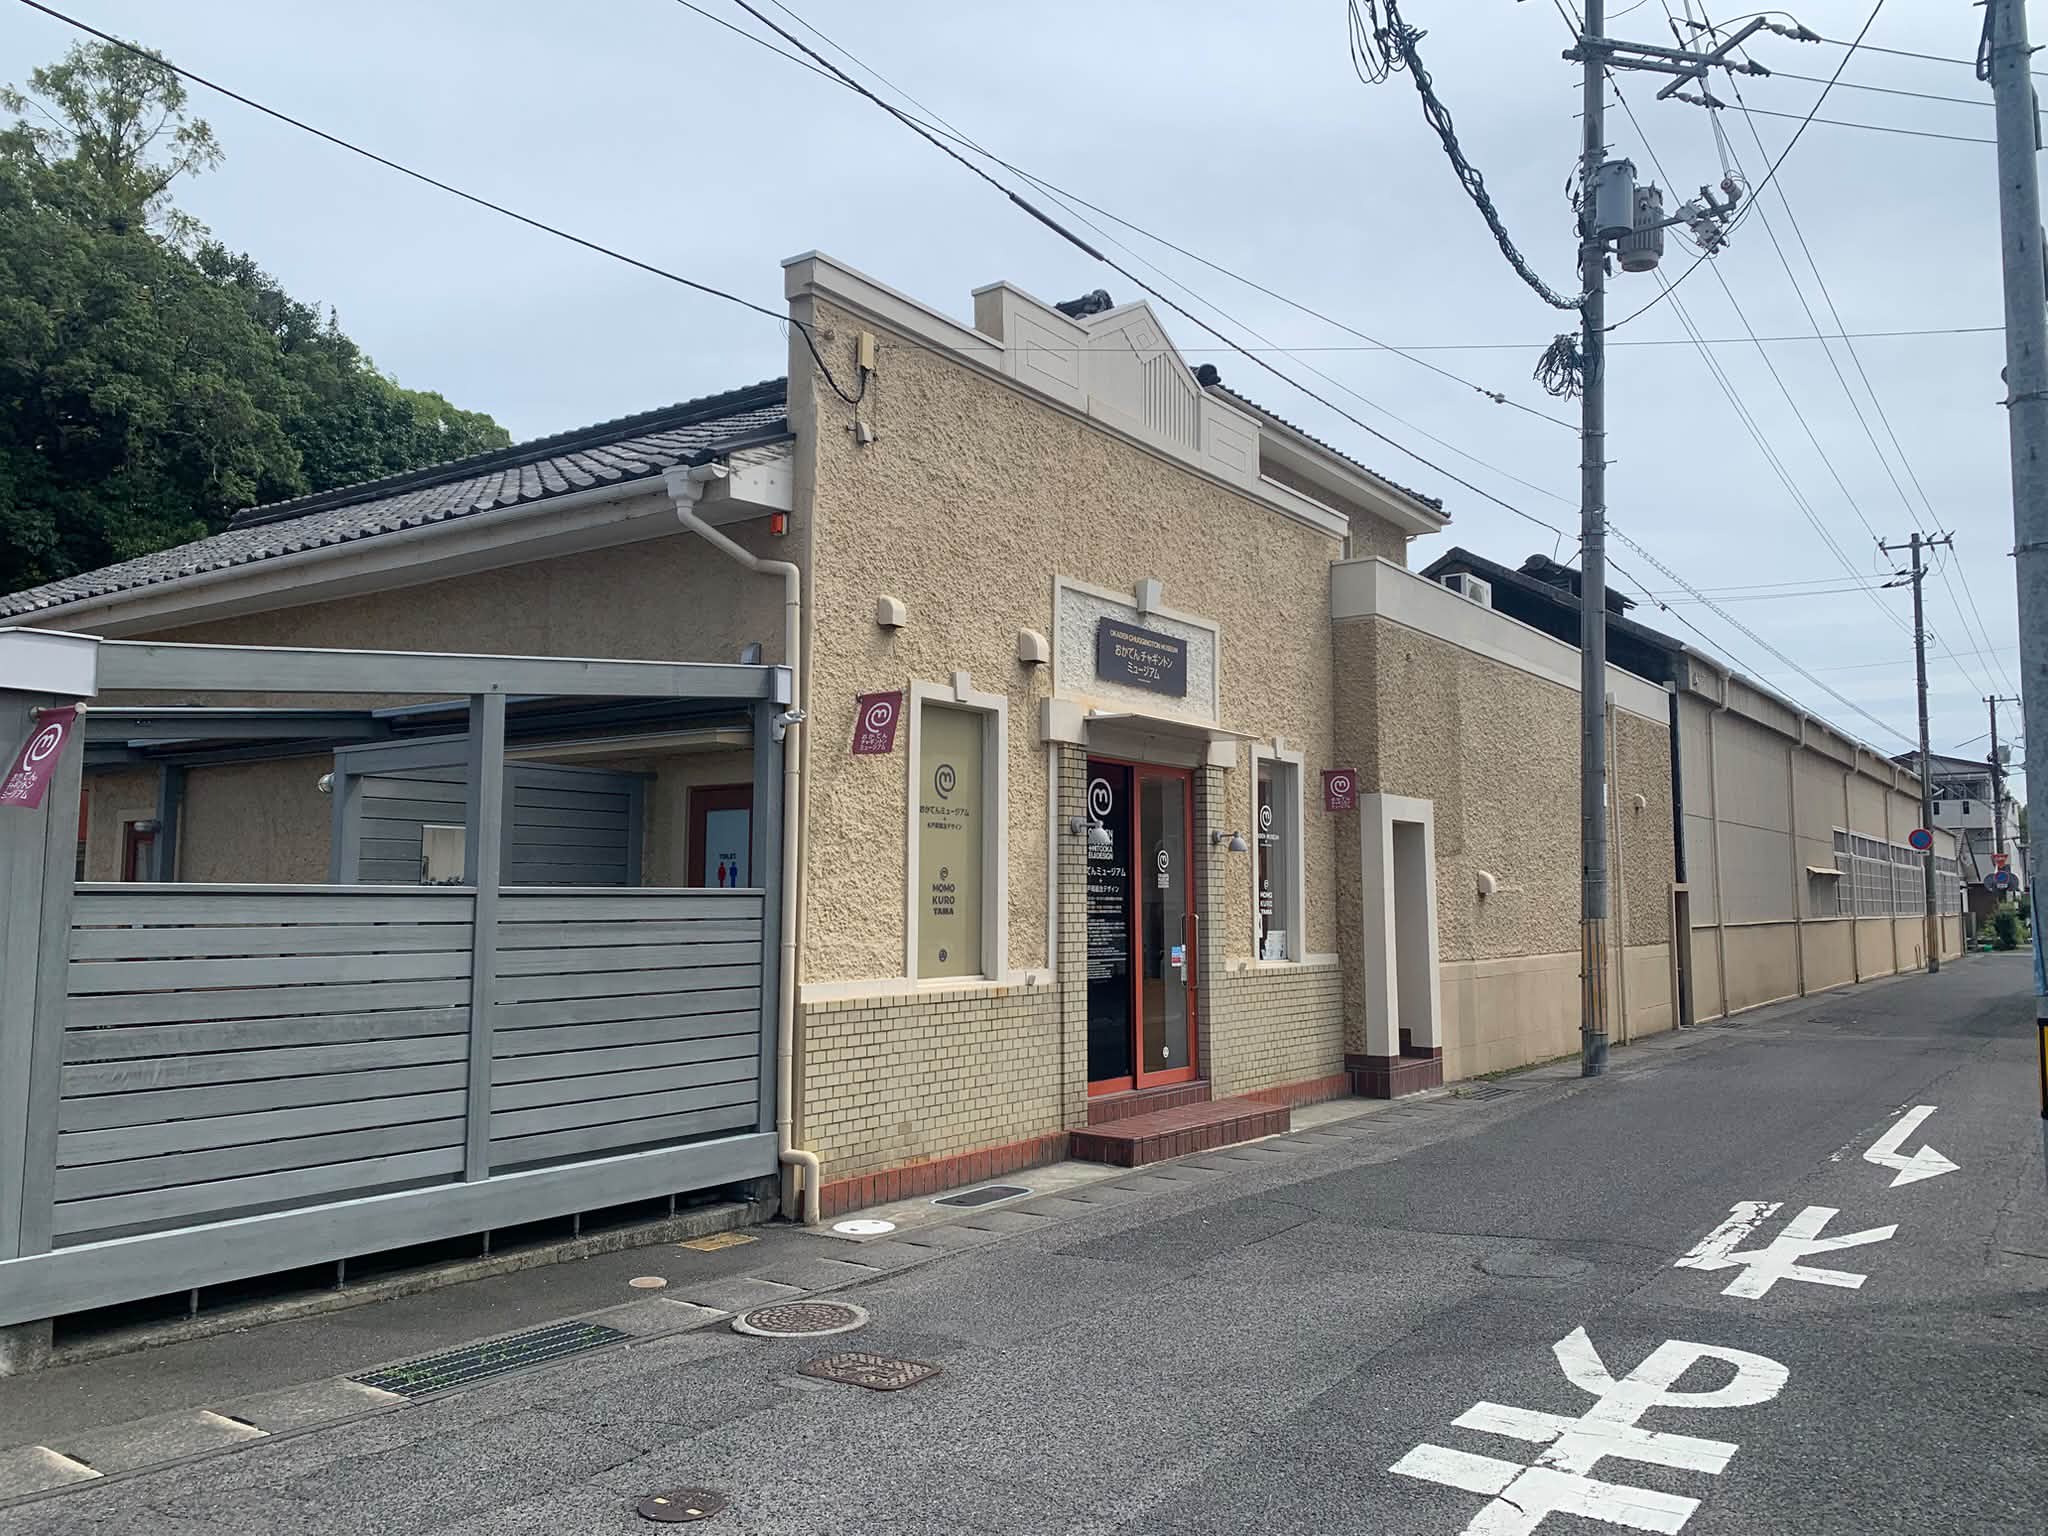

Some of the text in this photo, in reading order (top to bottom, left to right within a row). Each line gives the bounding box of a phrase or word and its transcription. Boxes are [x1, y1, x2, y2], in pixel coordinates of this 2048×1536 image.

[1127, 661, 1160, 680] ミュージアム
[932, 883, 955, 893] MOMO
[932, 895, 955, 905] KURO
[933, 907, 954, 916] TAMA
